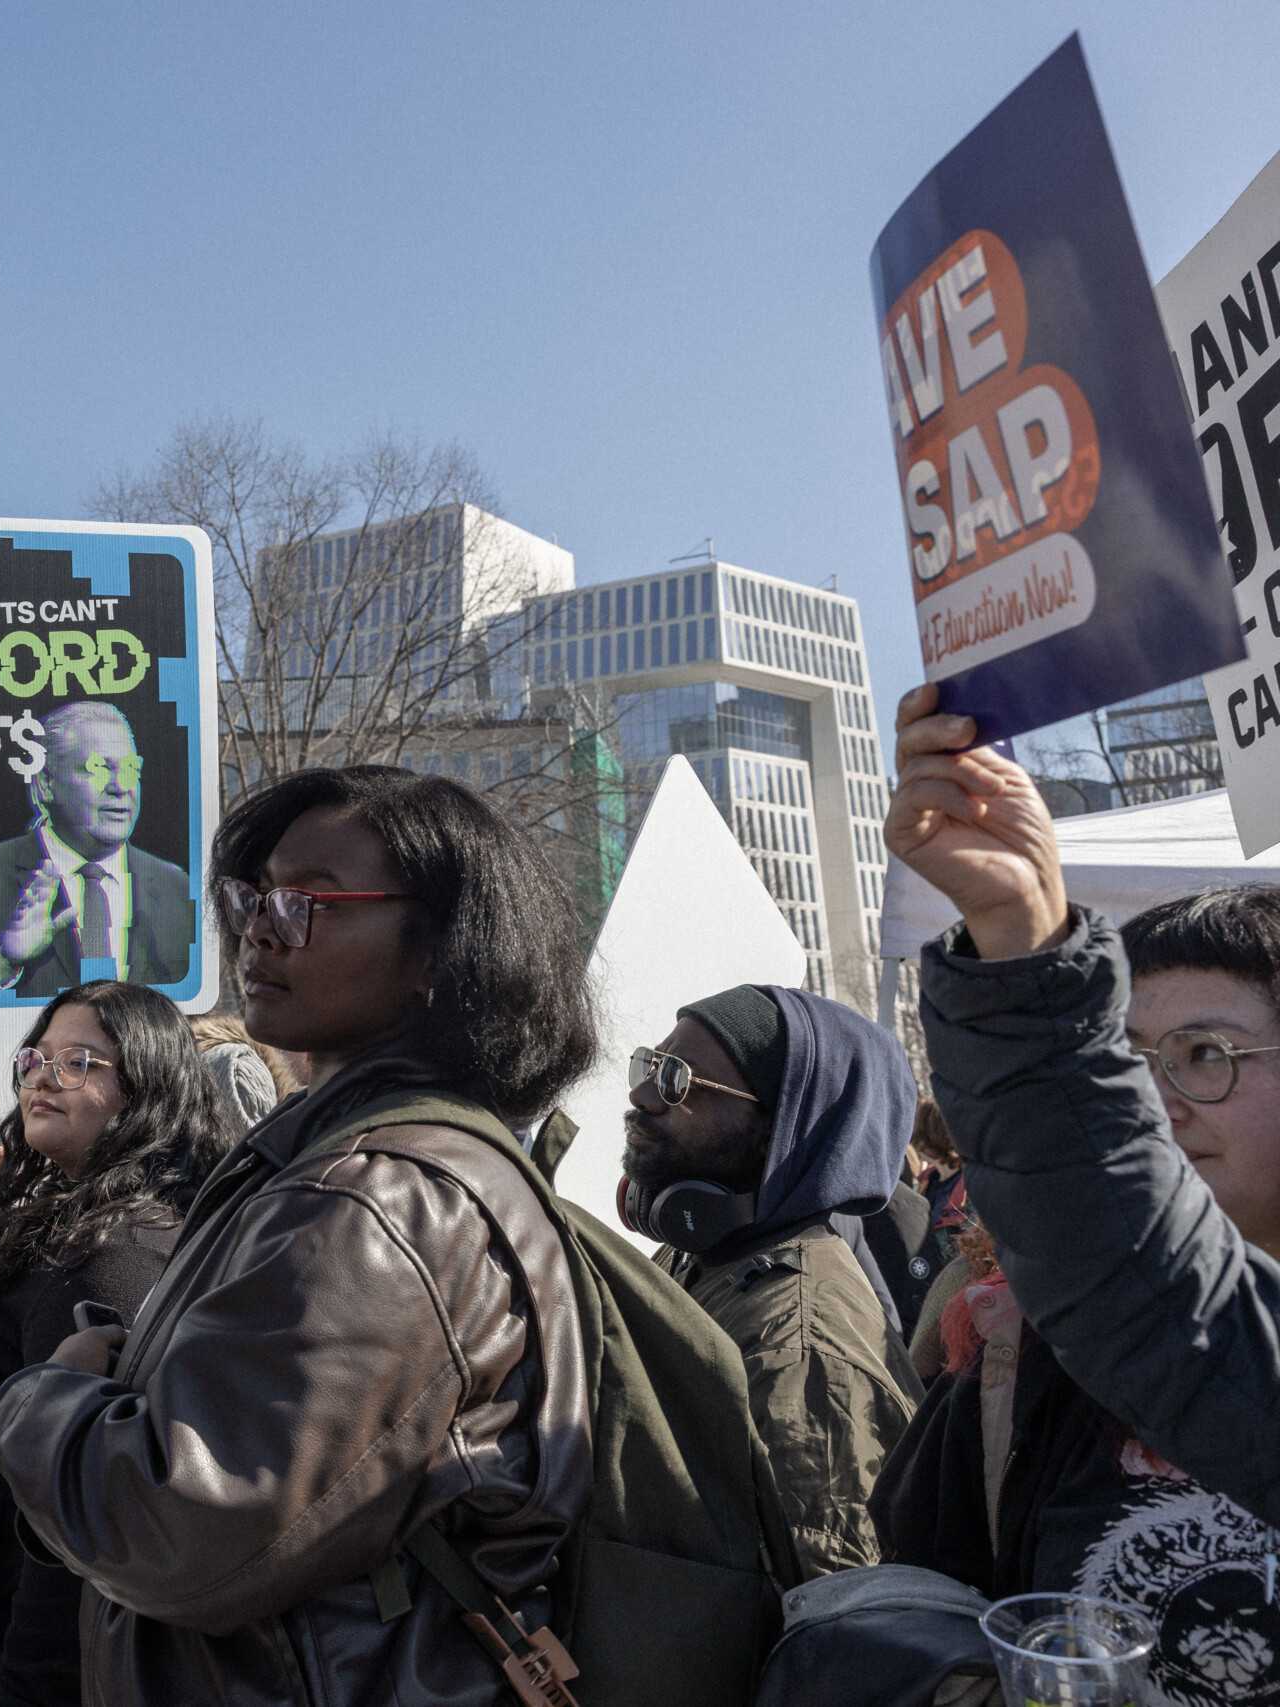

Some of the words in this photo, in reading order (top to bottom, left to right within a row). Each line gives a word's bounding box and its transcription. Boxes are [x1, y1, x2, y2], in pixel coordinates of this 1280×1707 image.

[39, 598, 119, 623] CAN'T
[931, 584, 1025, 664] Education
[1024, 550, 1078, 621] Now!
[1228, 661, 1280, 749] CA
